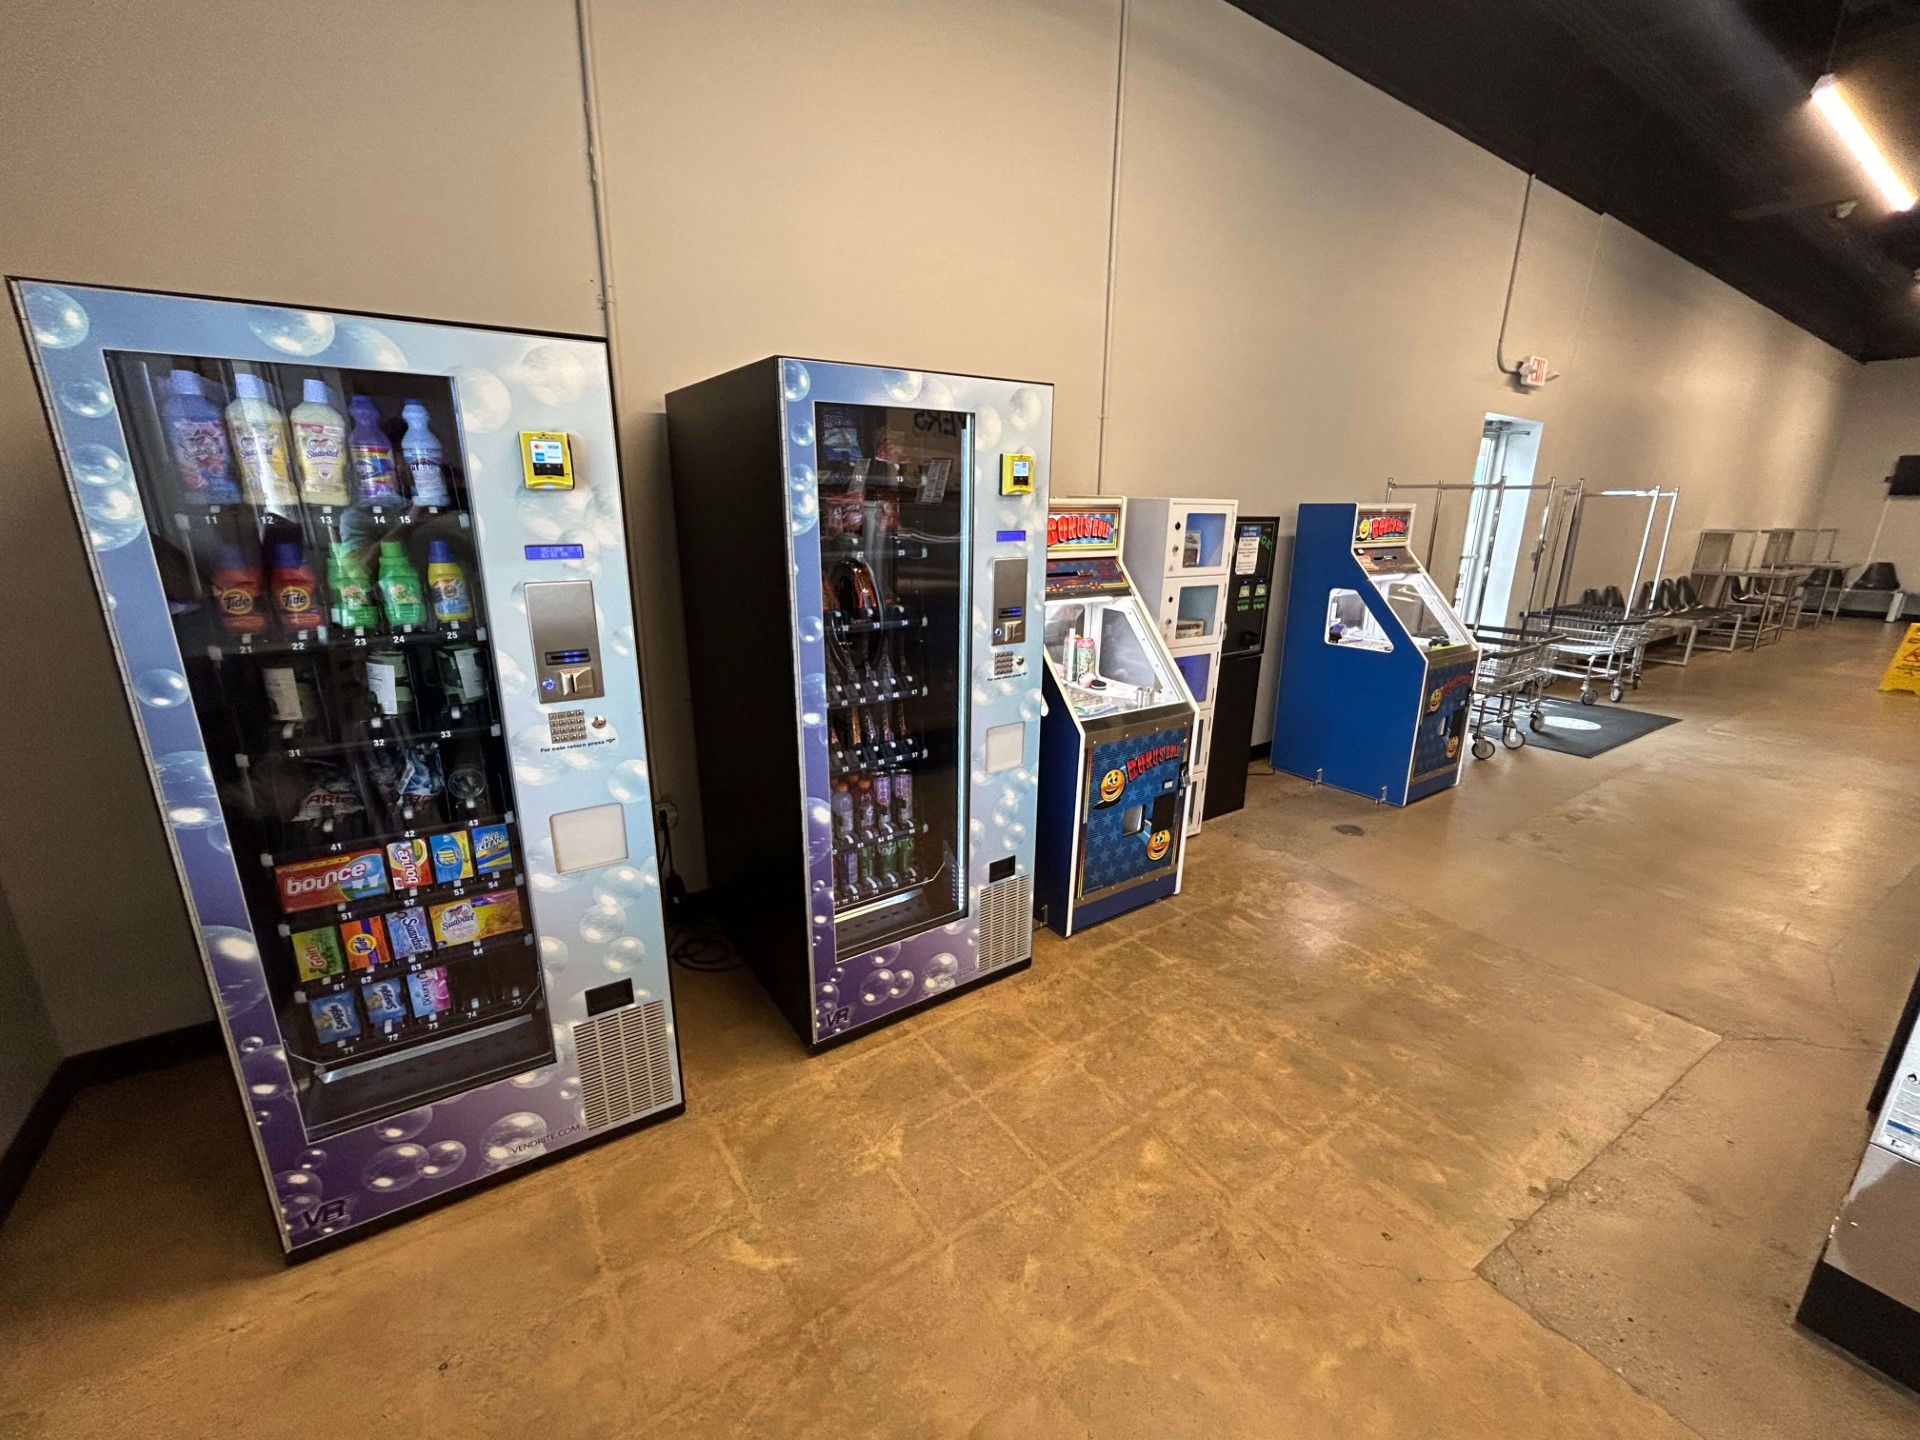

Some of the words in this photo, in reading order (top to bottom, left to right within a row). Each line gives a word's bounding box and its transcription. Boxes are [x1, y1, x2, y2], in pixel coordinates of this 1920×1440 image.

[306, 450, 339, 459] Suavitel
[204, 516, 218, 524] 11
[261, 516, 274, 524] 12
[319, 516, 332, 524] 13
[373, 516, 386, 524] 14
[399, 516, 411, 524] 15
[223, 596, 250, 609] Tide
[281, 593, 307, 607] Tide
[240, 646, 252, 654] 21
[292, 642, 305, 650] 22
[354, 638, 367, 646] 23
[392, 636, 405, 644] 24
[288, 749, 301, 757] 31
[373, 739, 385, 747] 32
[440, 730, 451, 738] 33
[330, 843, 342, 851] 41
[404, 830, 415, 838] 42
[468, 819, 479, 827] 43
[476, 836, 504, 852] CLEAN
[397, 848, 419, 884] bounce
[285, 863, 367, 896] bounce
[341, 912, 352, 920] 51
[453, 888, 464, 896] 53
[442, 912, 475, 931] Suavitel
[401, 917, 428, 951] Suavitel
[355, 937, 373, 953] Tide
[360, 976, 372, 984] 62
[411, 963, 422, 971] 63
[473, 948, 484, 956] 64
[428, 1022, 438, 1030] 73
[510, 1123, 581, 1154] VENDRITE.COM
